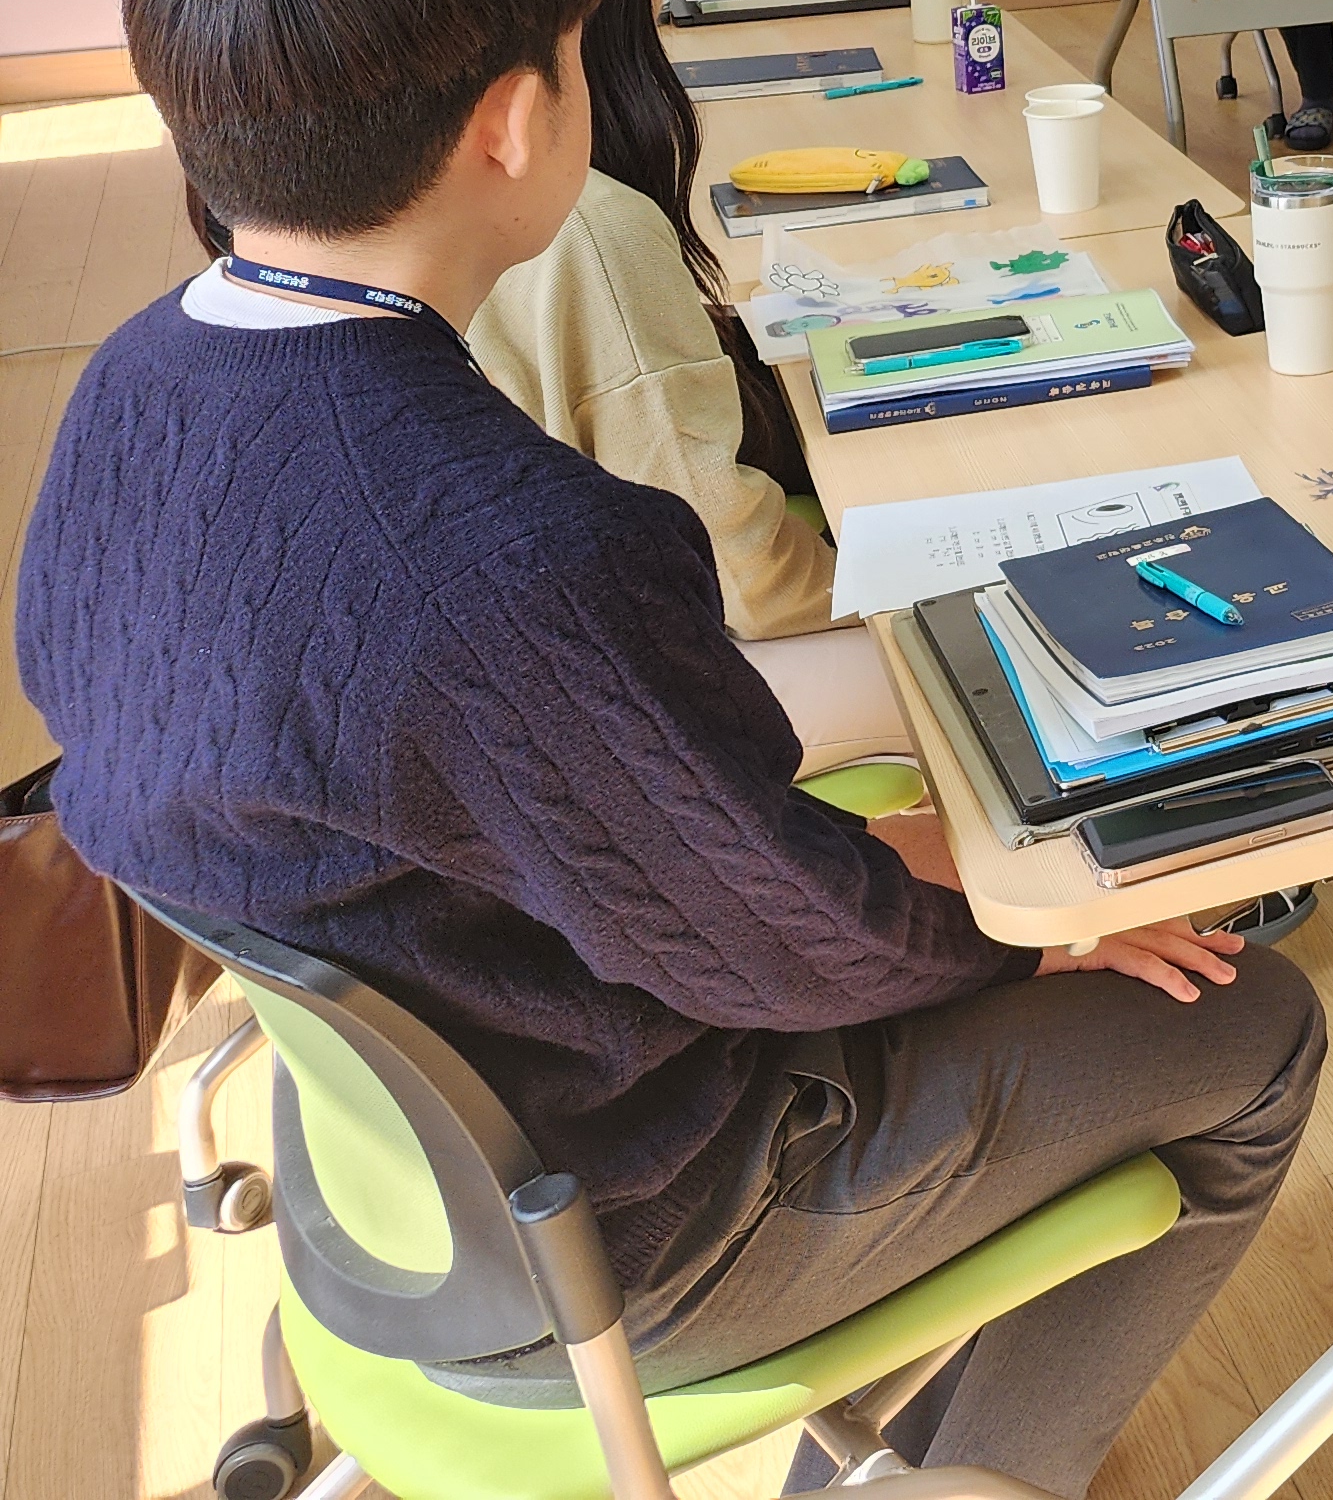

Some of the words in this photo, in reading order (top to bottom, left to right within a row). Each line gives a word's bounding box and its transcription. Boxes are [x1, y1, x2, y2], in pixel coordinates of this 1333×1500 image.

[258, 268, 310, 290] 중부초등학교
[364, 289, 423, 315] 중부초등학교
[1047, 378, 1112, 398] 교육실습록
[973, 395, 1009, 407] 2023
[1133, 637, 1178, 652] 2023
